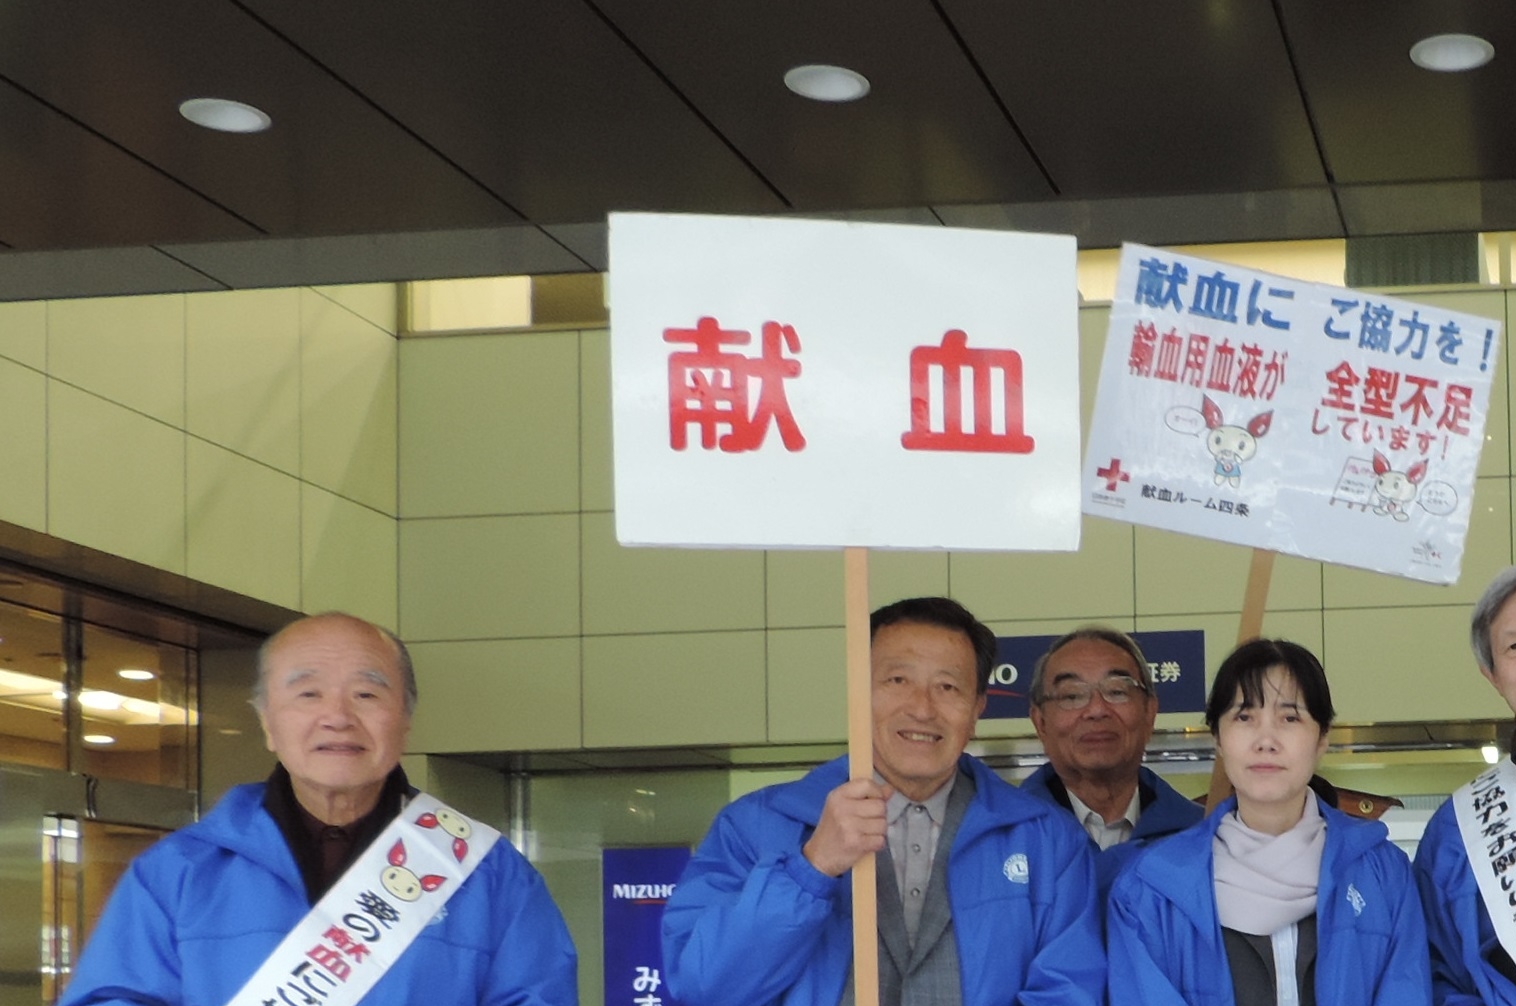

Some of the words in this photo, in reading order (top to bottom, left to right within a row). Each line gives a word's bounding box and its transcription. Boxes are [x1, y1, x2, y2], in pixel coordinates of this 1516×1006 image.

[1134, 256, 1295, 331] 献血に
[662, 316, 1035, 455] 献血
[1128, 319, 1289, 402] 輸血用血液が
[1320, 360, 1473, 437] 全型不足
[1141, 483, 1250, 517] 献血ルーム四条
